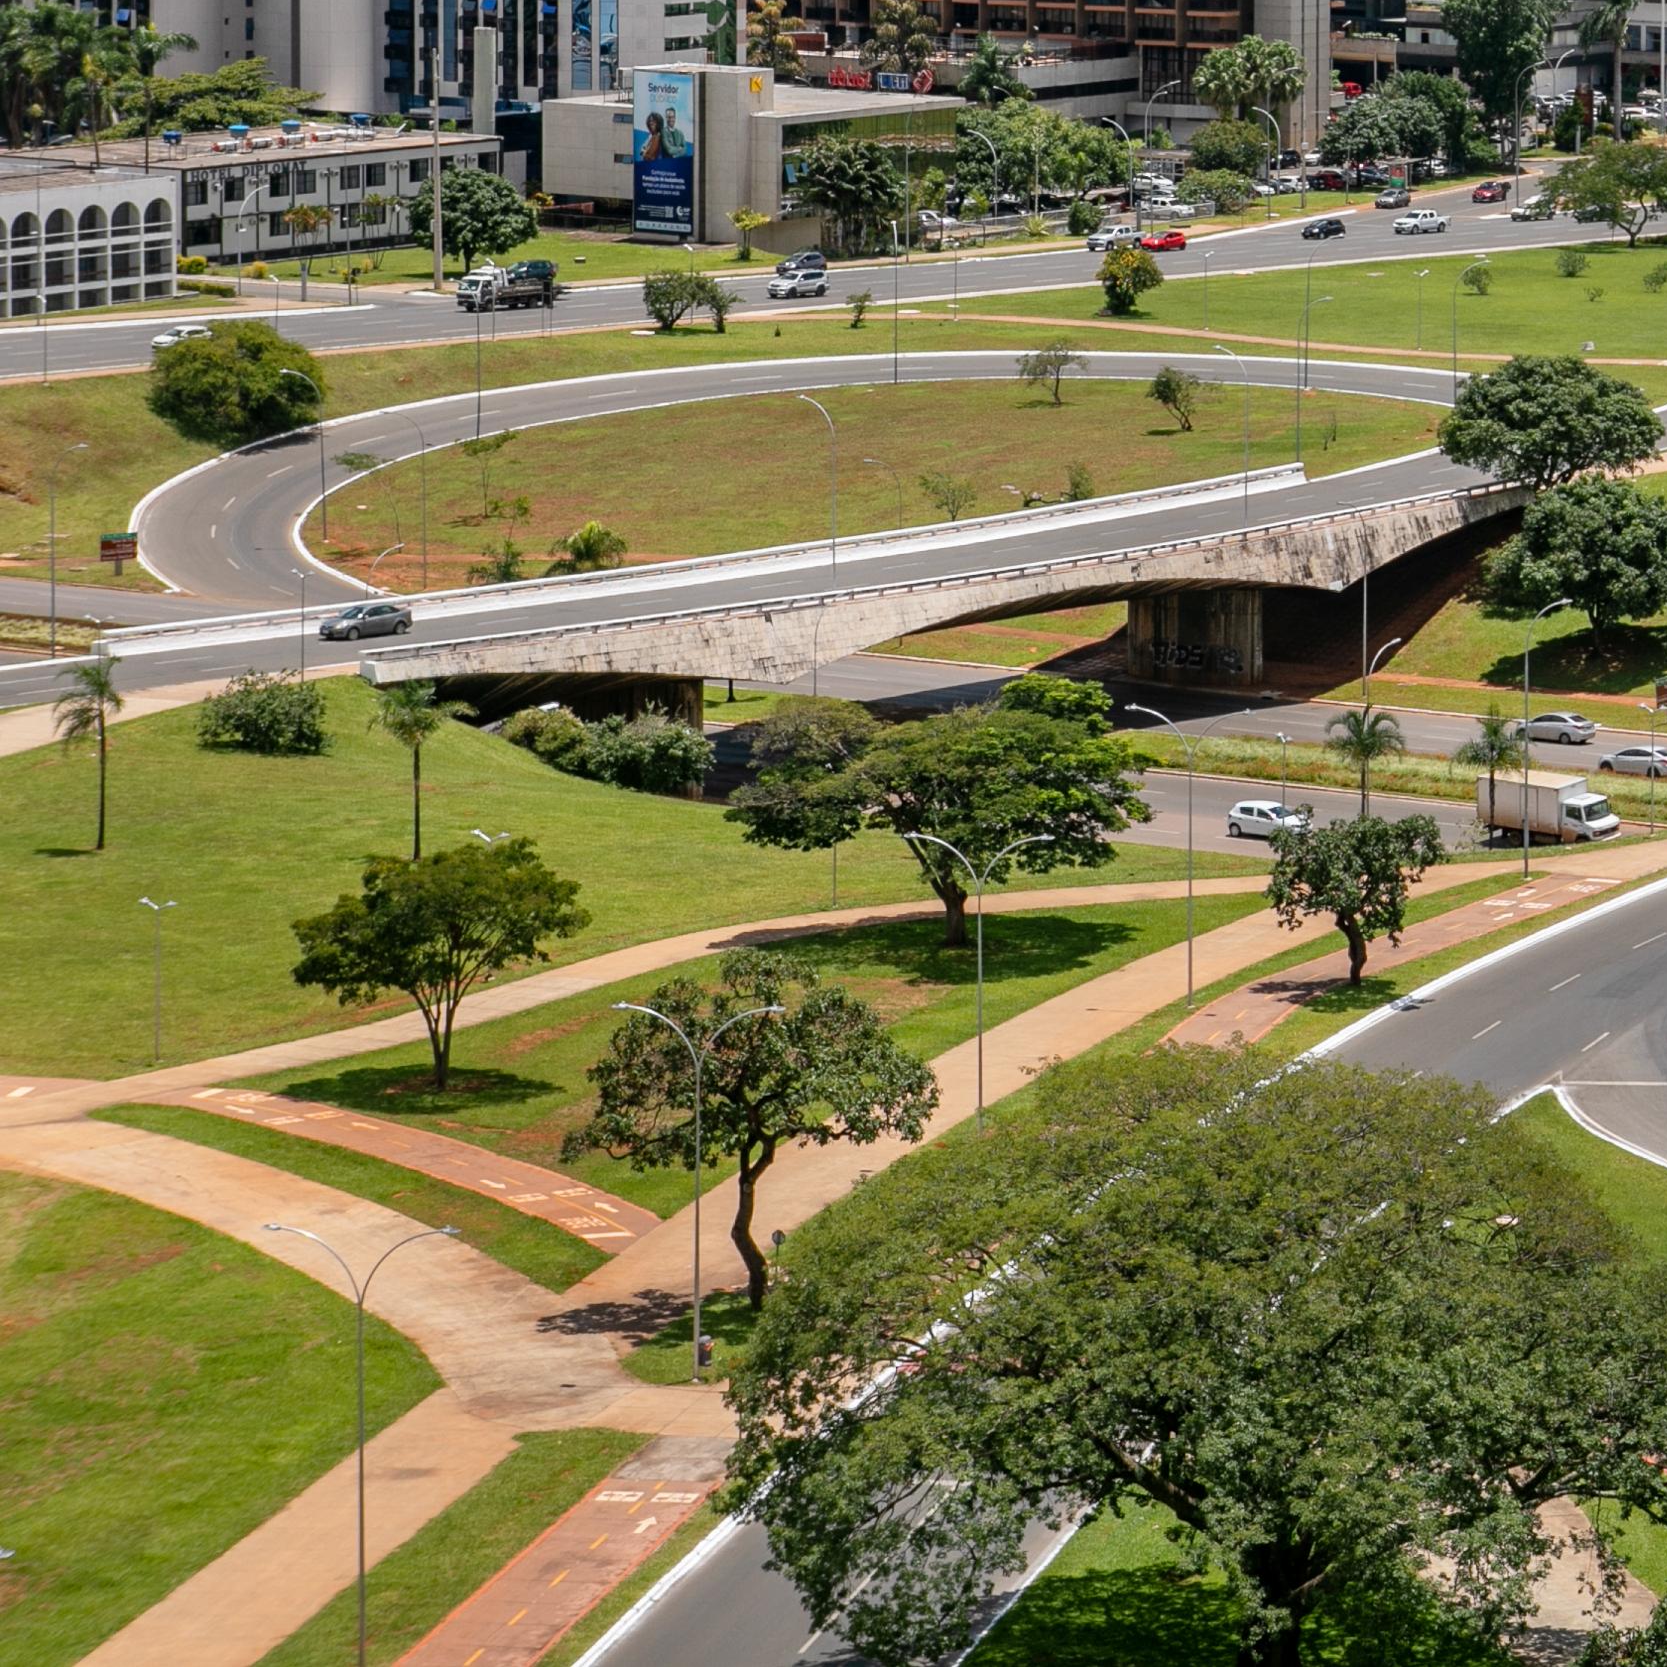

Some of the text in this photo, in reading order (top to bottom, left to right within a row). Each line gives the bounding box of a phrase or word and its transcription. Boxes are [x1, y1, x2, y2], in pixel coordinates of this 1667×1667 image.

[647, 81, 680, 94] Servidor
[190, 160, 307, 182] HOTEL DIPLOMAT
